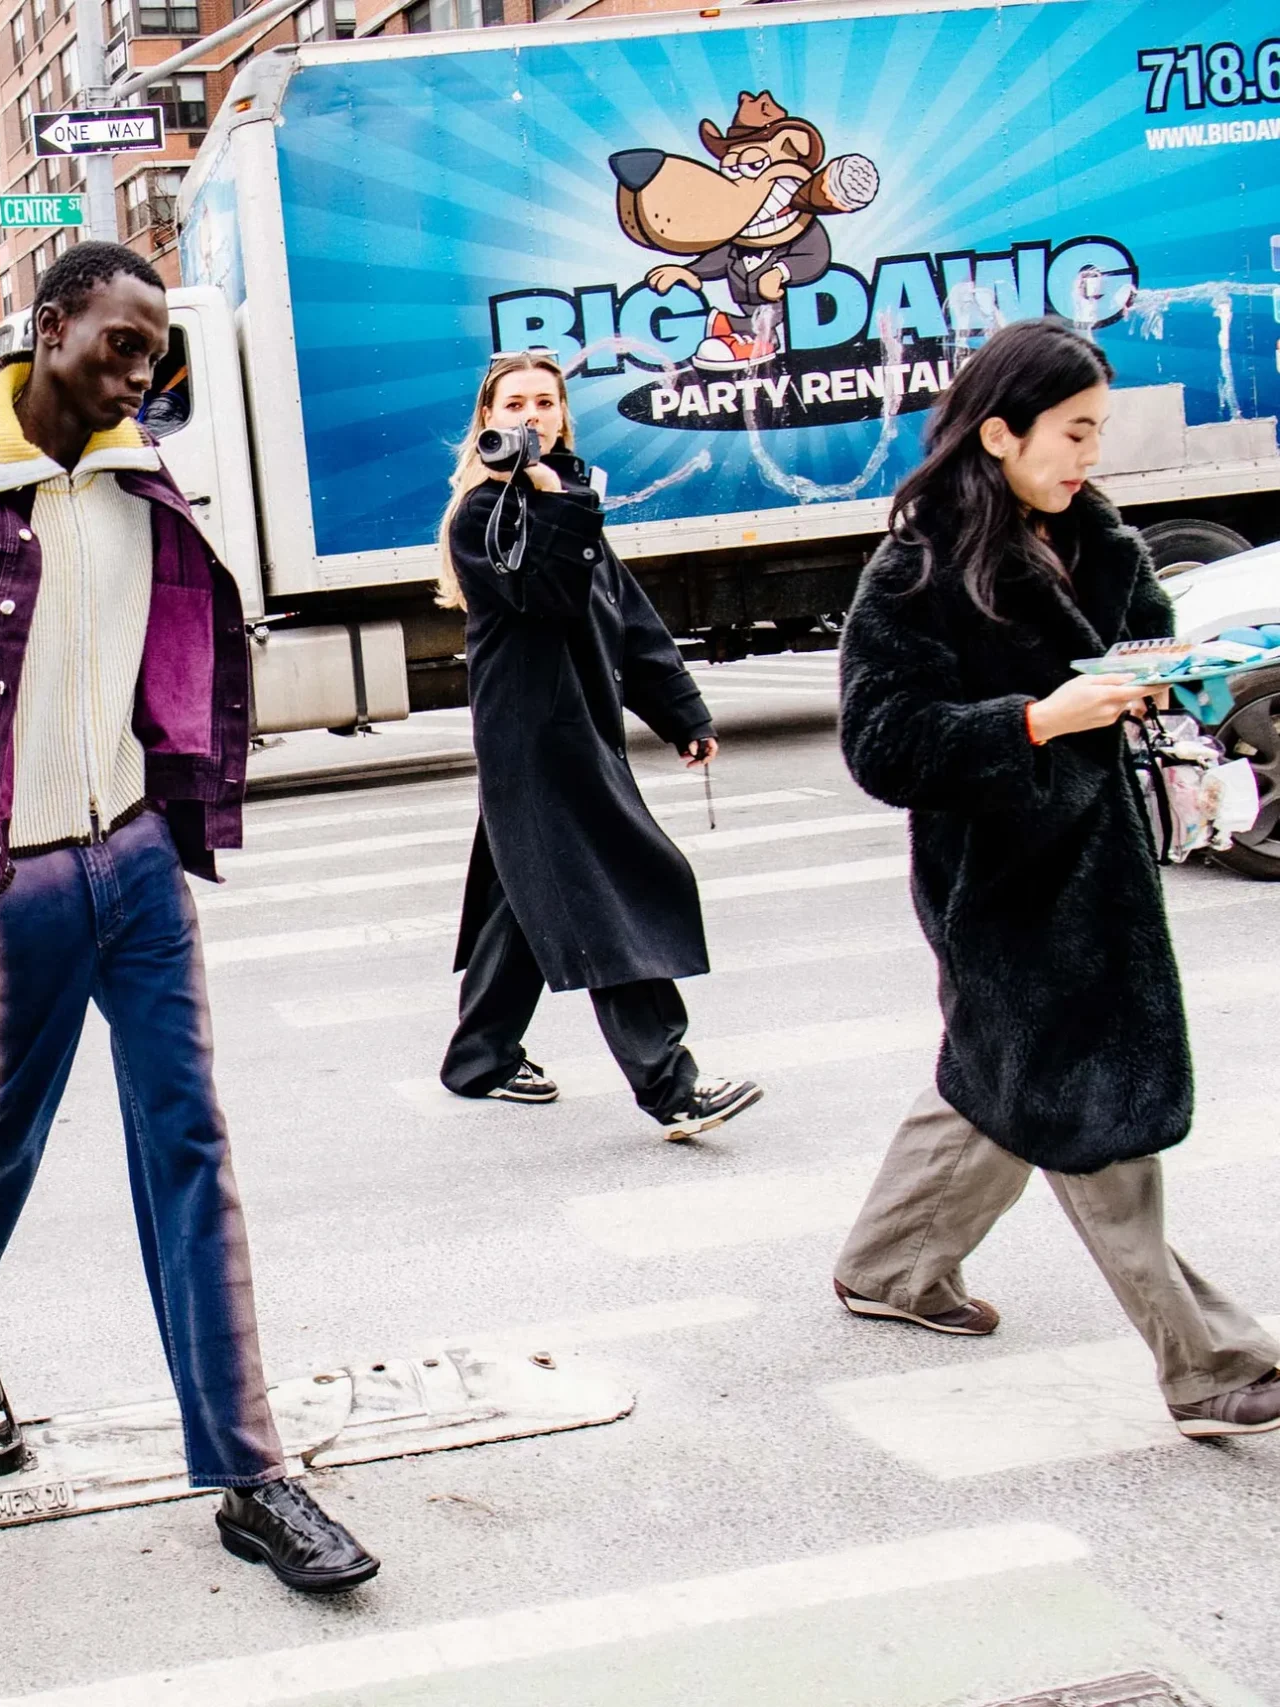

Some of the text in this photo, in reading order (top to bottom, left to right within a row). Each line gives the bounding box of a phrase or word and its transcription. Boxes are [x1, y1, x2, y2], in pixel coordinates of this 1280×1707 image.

[1137, 38, 1280, 114] 718.6
[54, 121, 145, 142] ONE WAY
[3, 197, 81, 224] CENTRE ST
[489, 236, 1138, 378] BIG DAWG
[651, 359, 966, 421] PARTY RENTAL
[46, 1484, 69, 1510] 20
